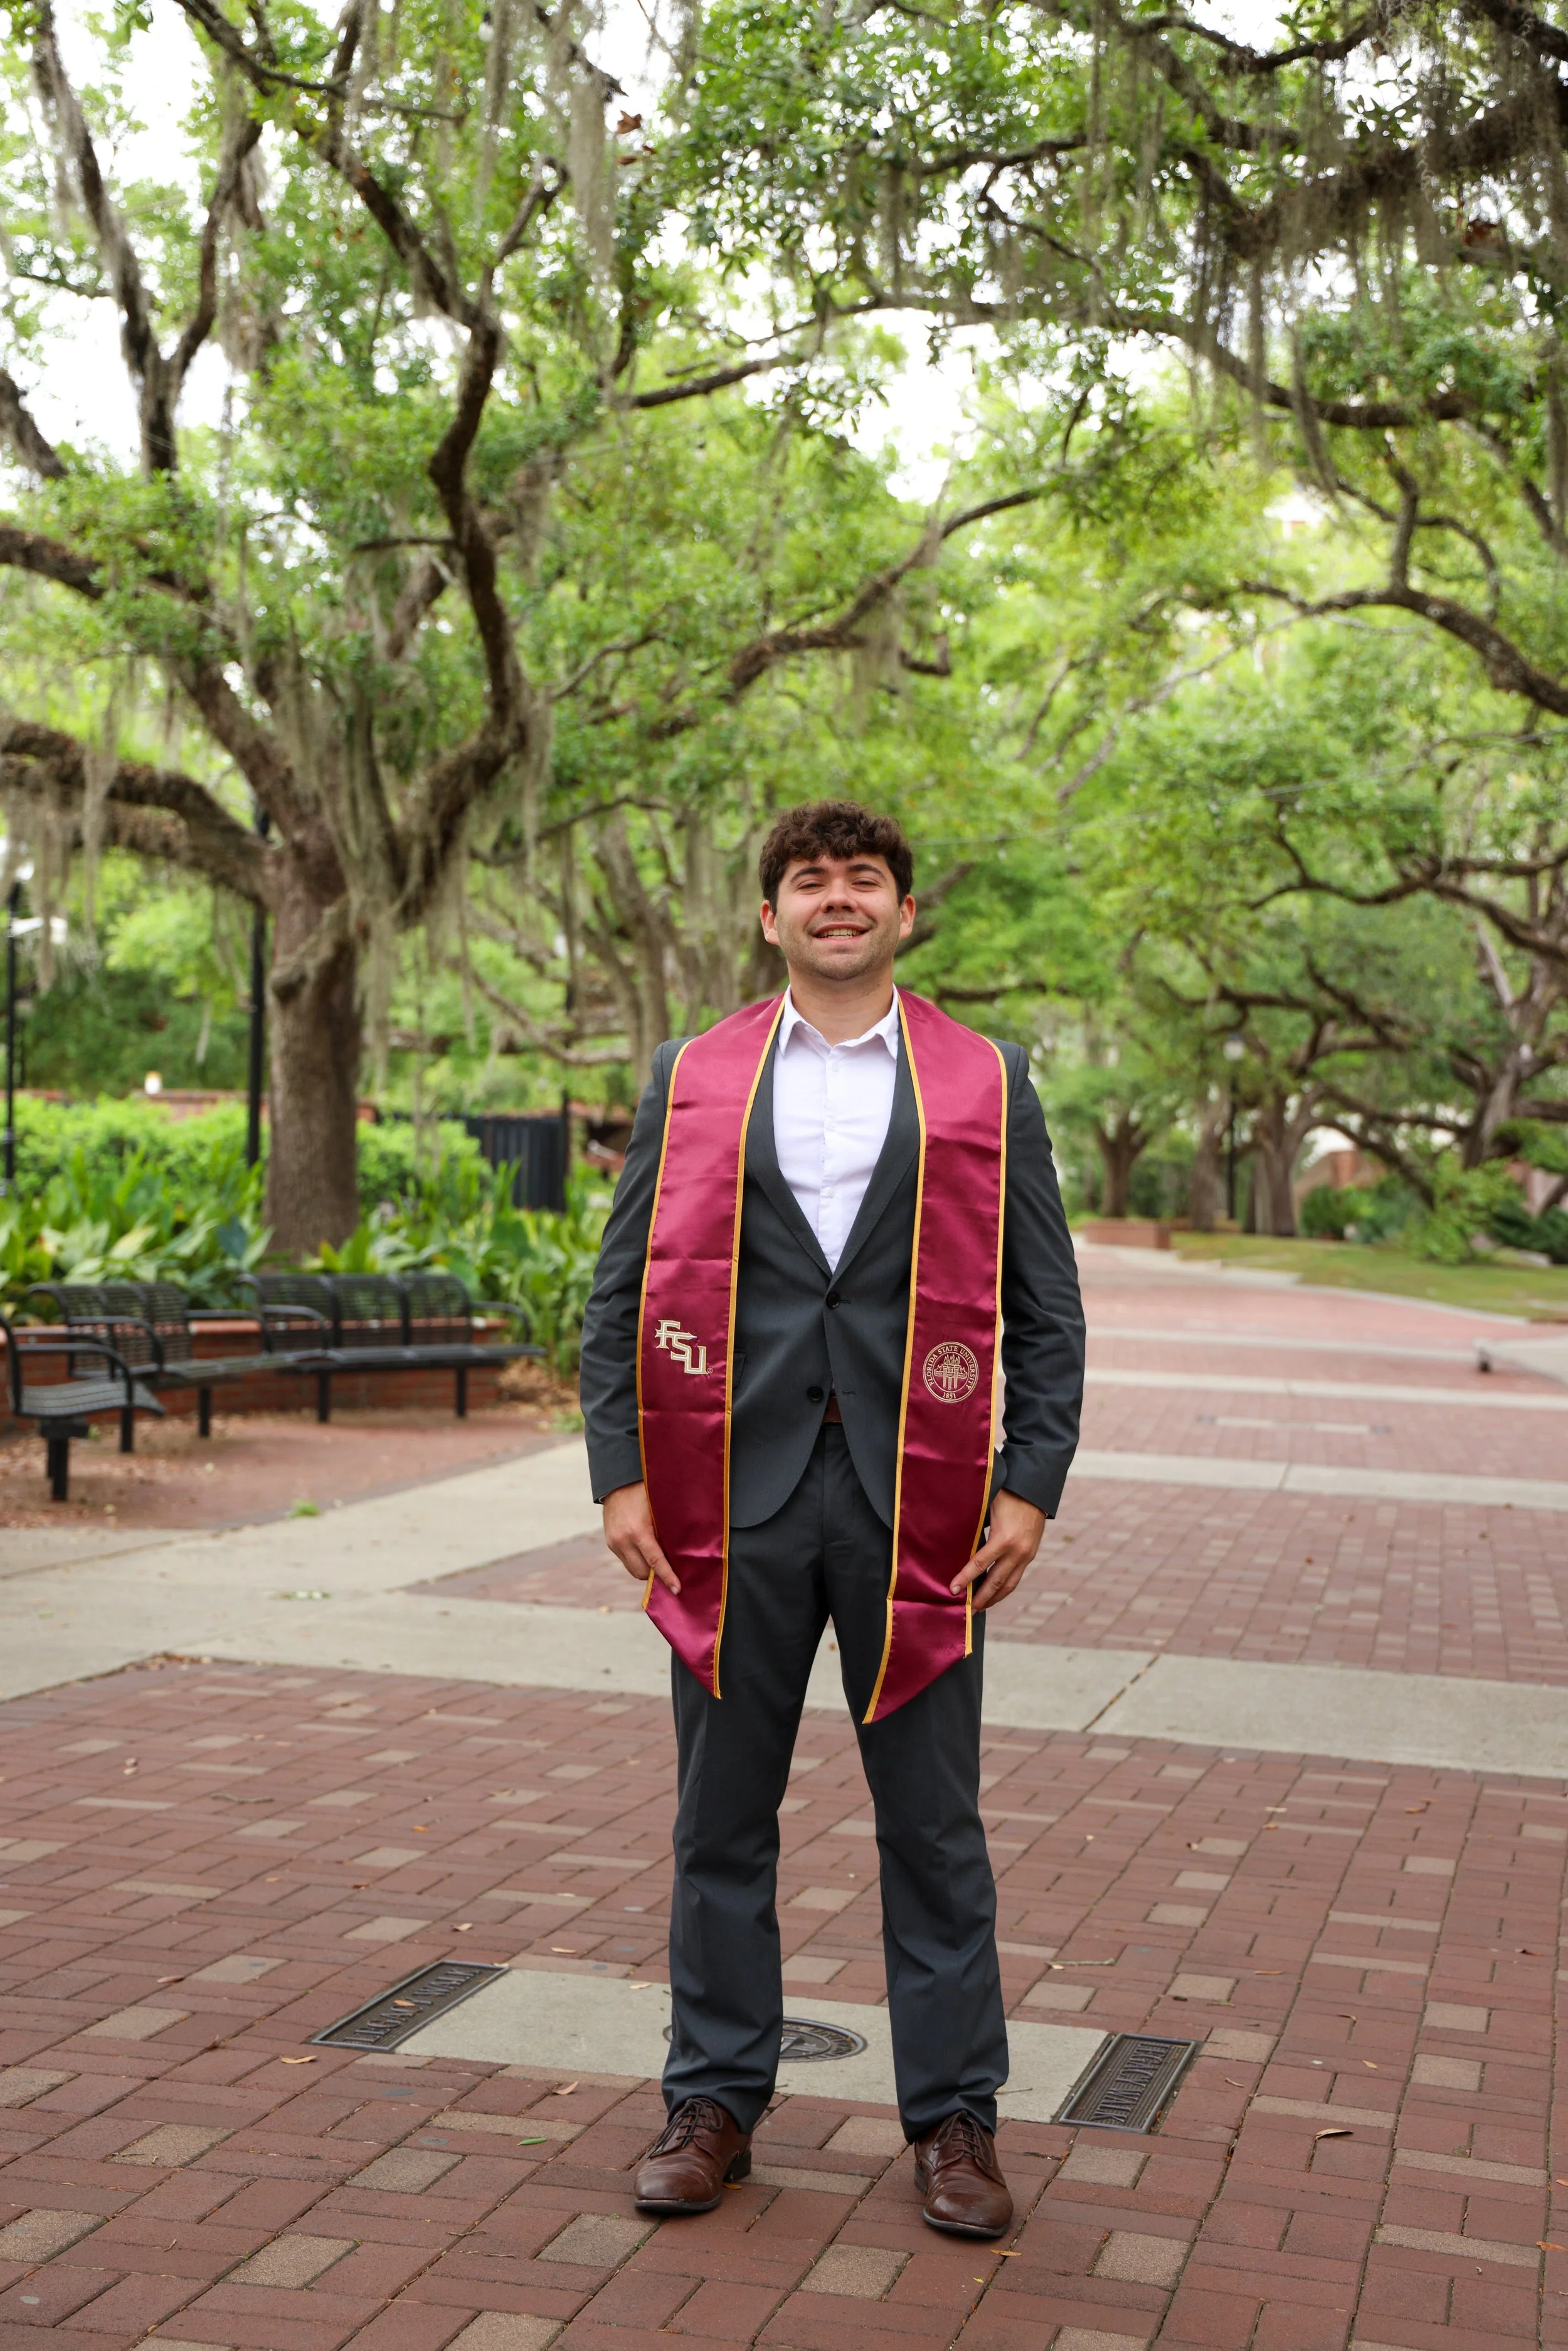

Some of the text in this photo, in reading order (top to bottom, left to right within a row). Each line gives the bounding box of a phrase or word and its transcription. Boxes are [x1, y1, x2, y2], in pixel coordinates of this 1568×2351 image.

[655, 1320, 708, 1374] FSU
[926, 1345, 975, 1390] FLORIDA STATE UNIVERSITY
[343, 1968, 481, 2043] LEGACY WALK
[1090, 2042, 1170, 2123] LEGACY WALK
